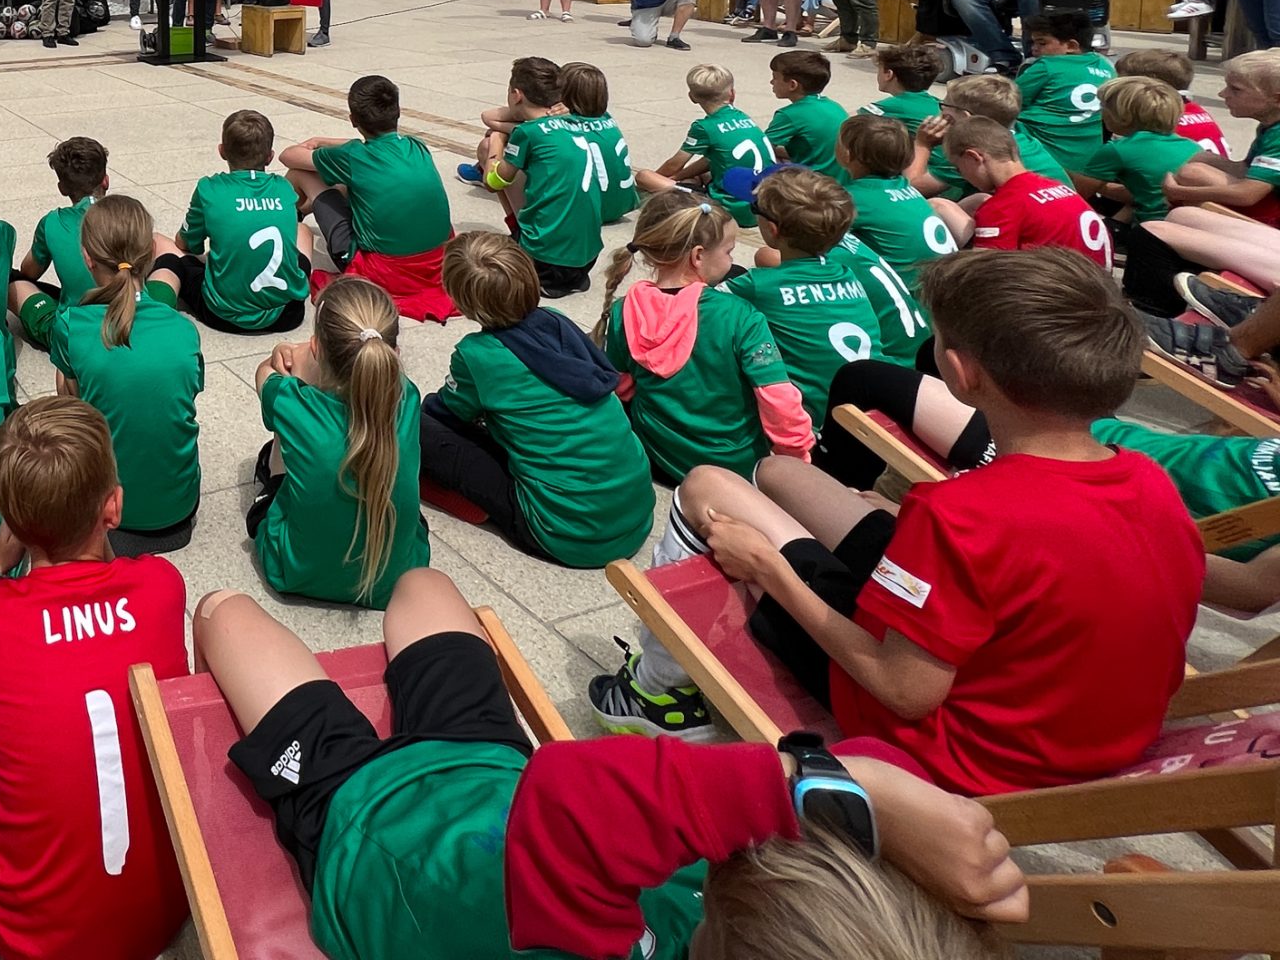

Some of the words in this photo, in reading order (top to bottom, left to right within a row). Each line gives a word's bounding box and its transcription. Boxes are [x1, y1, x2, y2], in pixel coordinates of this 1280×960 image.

[235, 197, 283, 213] JULIUS
[248, 226, 288, 293] 2
[1080, 210, 1113, 273] 9
[42, 597, 136, 645] LINUS
[84, 689, 130, 876] 1
[270, 740, 300, 776] adidas
